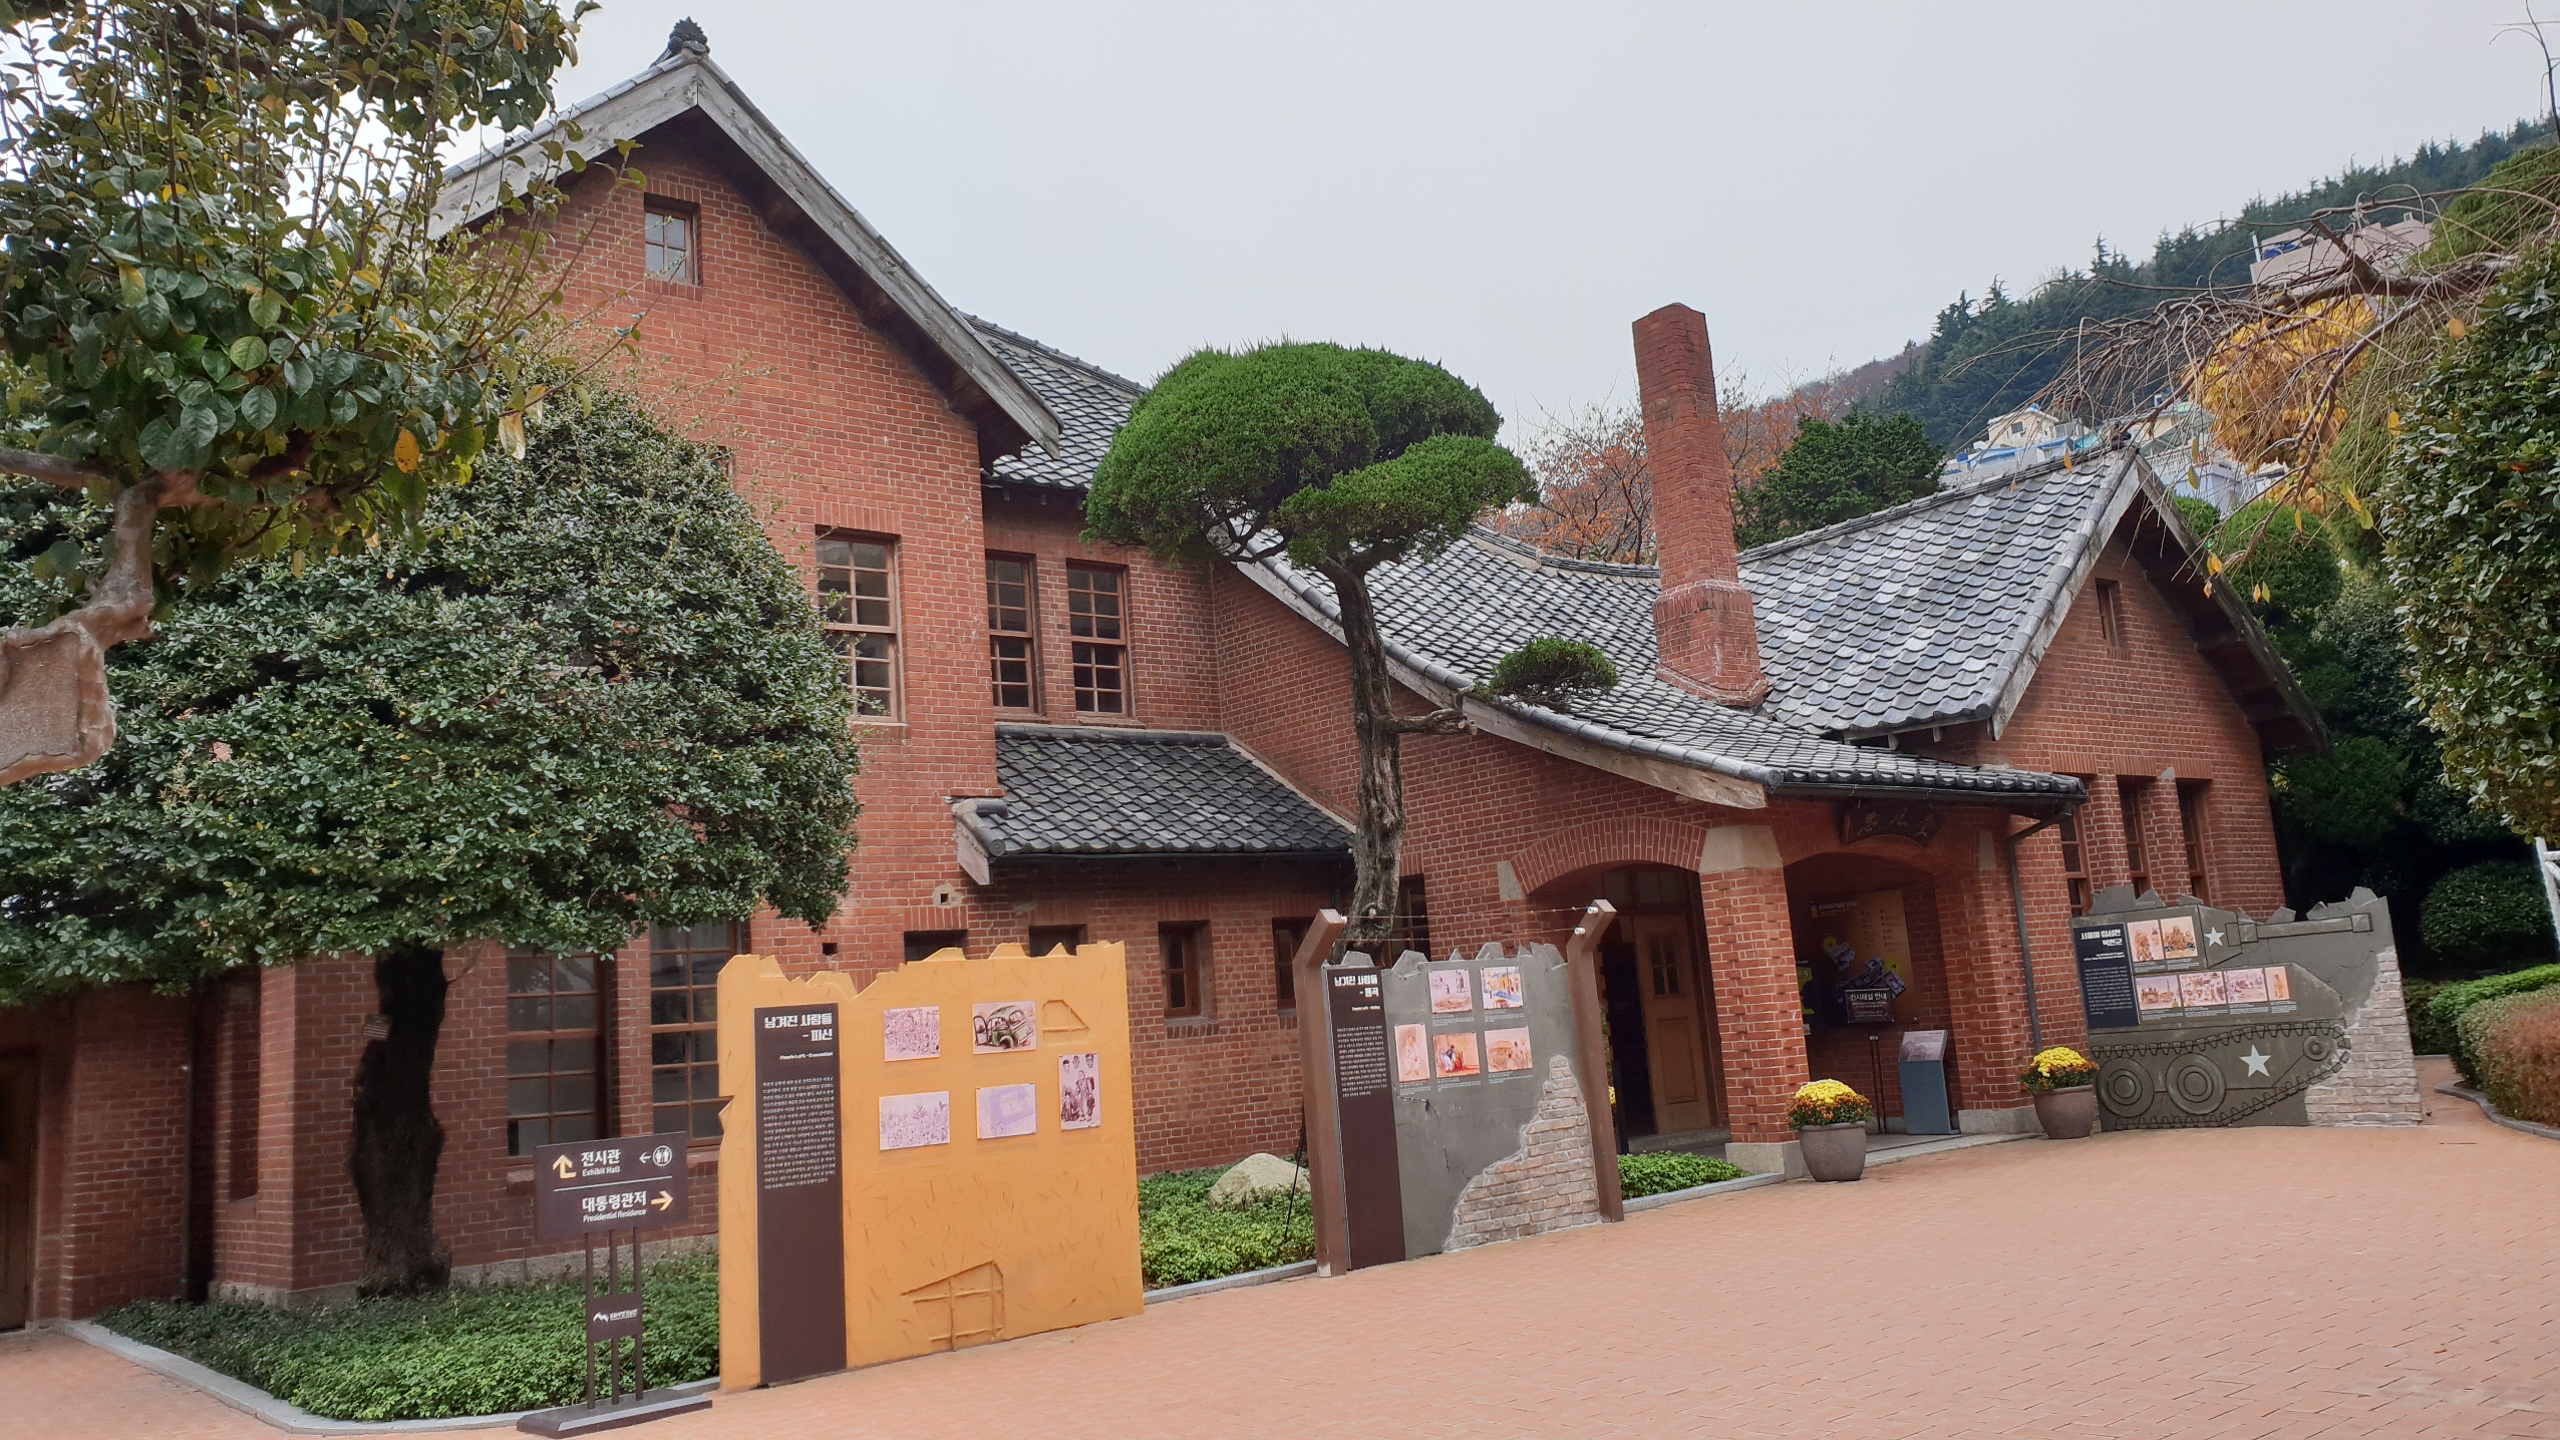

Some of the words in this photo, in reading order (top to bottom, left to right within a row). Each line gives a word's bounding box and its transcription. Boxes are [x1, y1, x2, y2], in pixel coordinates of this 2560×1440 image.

[1874, 992, 1887, 1000] 안내
[764, 1015, 798, 1029] 남겨진
[799, 1012, 832, 1027] 사람들
[811, 1028, 833, 1042] 피신
[581, 1148, 621, 1167] 전시관
[582, 1168, 606, 1177] Exhibit
[606, 1166, 621, 1174] Hall
[582, 1190, 647, 1213] 대통령관저
[583, 1211, 617, 1223] Presidential
[617, 1209, 647, 1219] Residence
